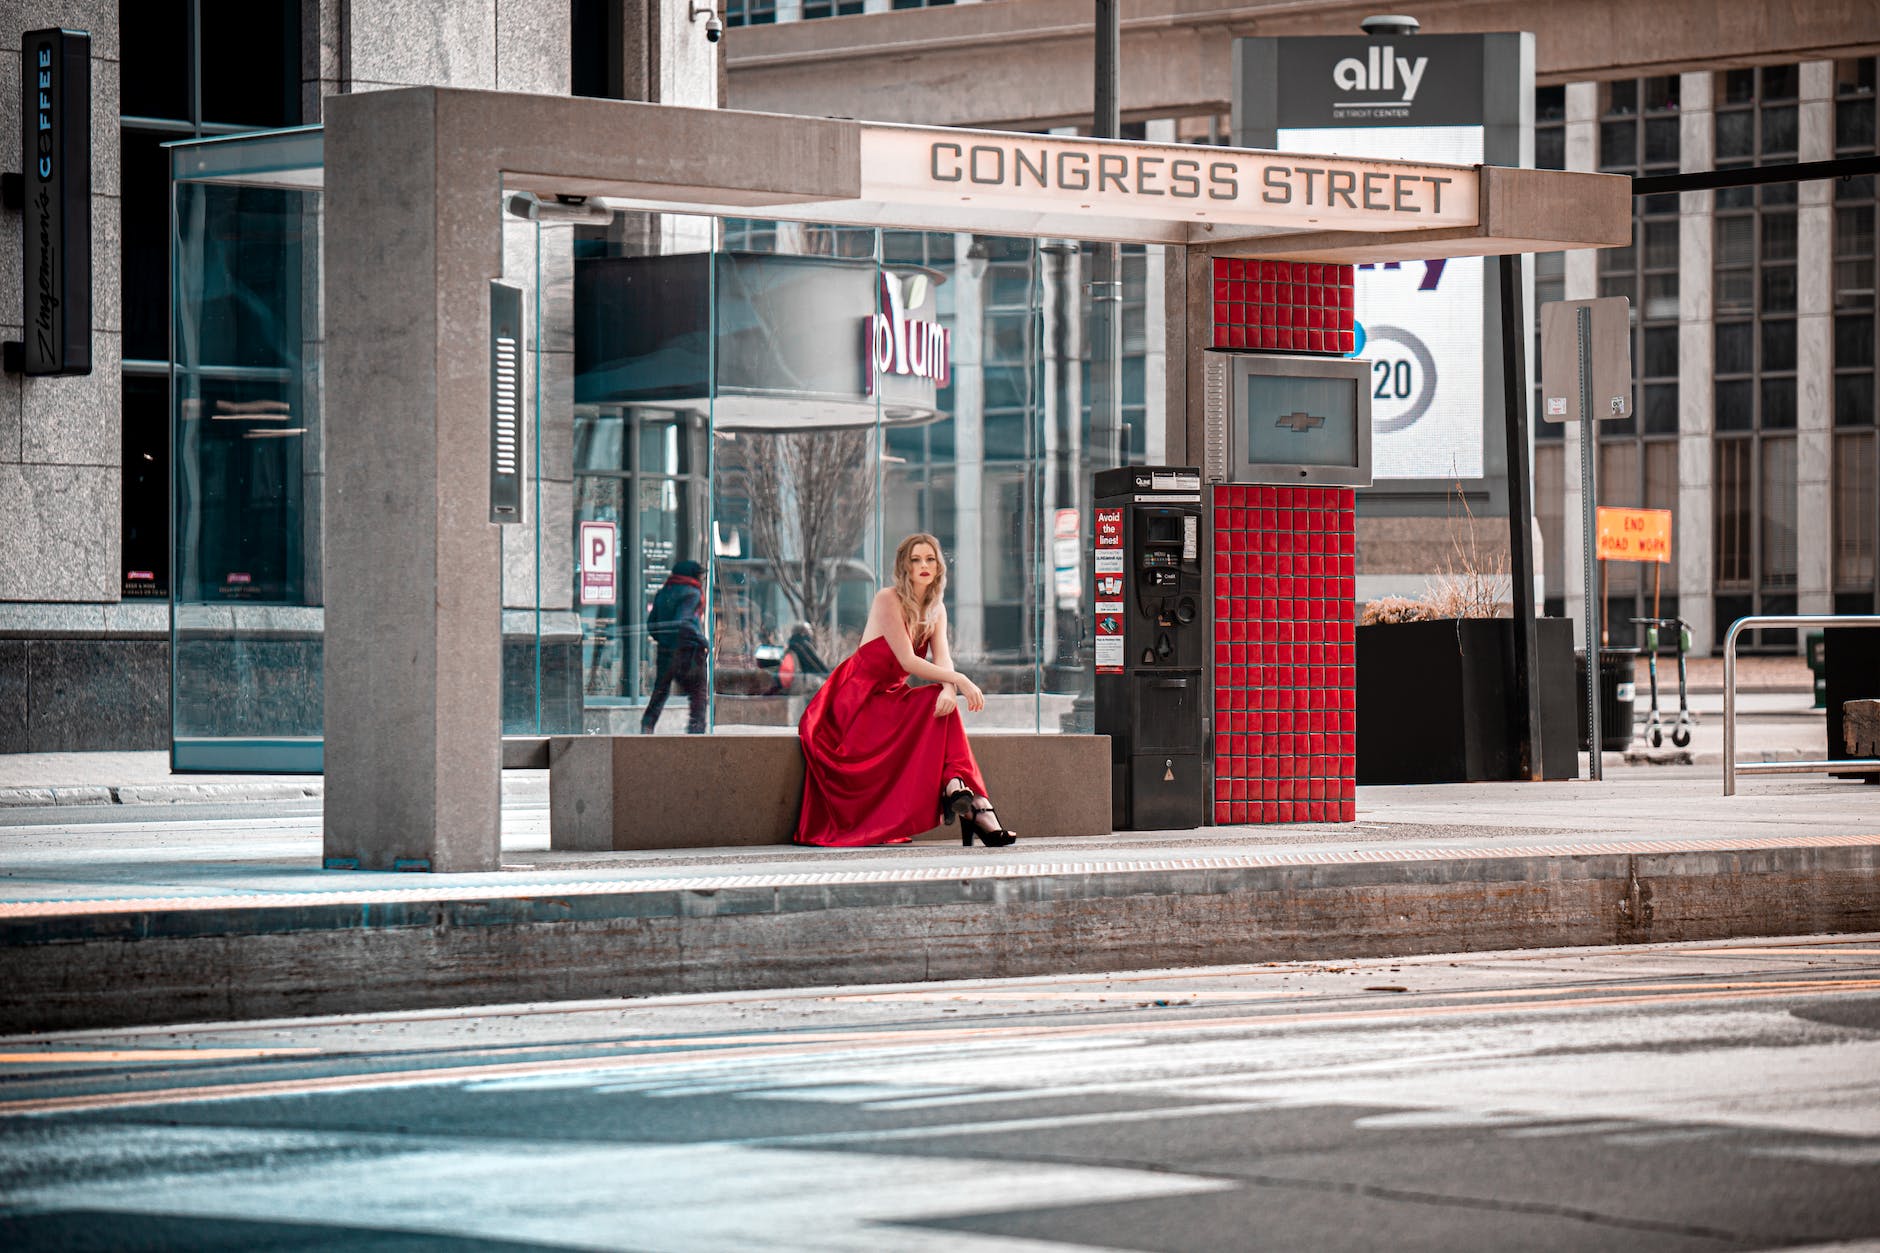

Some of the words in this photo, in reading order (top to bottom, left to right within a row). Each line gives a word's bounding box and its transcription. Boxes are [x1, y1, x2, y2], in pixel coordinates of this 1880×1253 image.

[1332, 45, 1429, 101] ally
[38, 48, 52, 178] COFFEE
[1333, 109, 1371, 119] DETROIT
[1372, 109, 1410, 118] CENTER
[931, 142, 1239, 200] CONGRESS
[1262, 166, 1452, 213] STREET
[871, 271, 945, 398] plum
[1098, 512, 1120, 522] Avoid
[1624, 516, 1645, 532] END
[1102, 523, 1116, 534] the
[1099, 534, 1119, 545] lines!
[1601, 535, 1629, 551] ROAD
[1639, 537, 1666, 553] WORK
[592, 537, 606, 566] P
